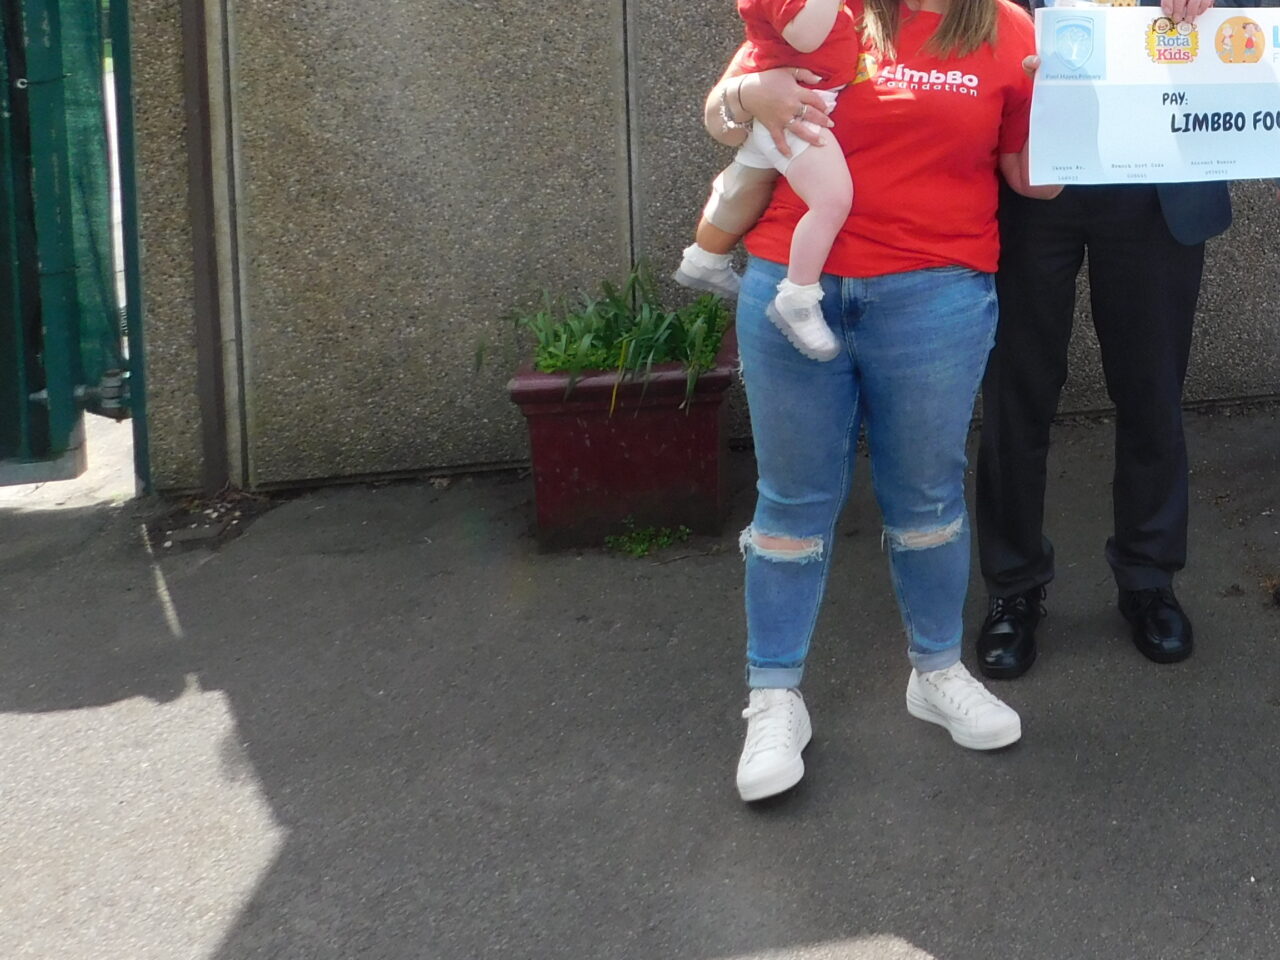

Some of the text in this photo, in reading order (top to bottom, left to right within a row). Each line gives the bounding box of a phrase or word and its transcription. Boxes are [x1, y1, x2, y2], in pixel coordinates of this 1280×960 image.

[1156, 34, 1191, 47] Rota
[1156, 47, 1191, 61] Kids
[882, 64, 979, 87] LimbBo
[877, 77, 977, 97] Foundation
[1162, 91, 1188, 106] PAY:
[1171, 112, 1246, 133] LIMBBO
